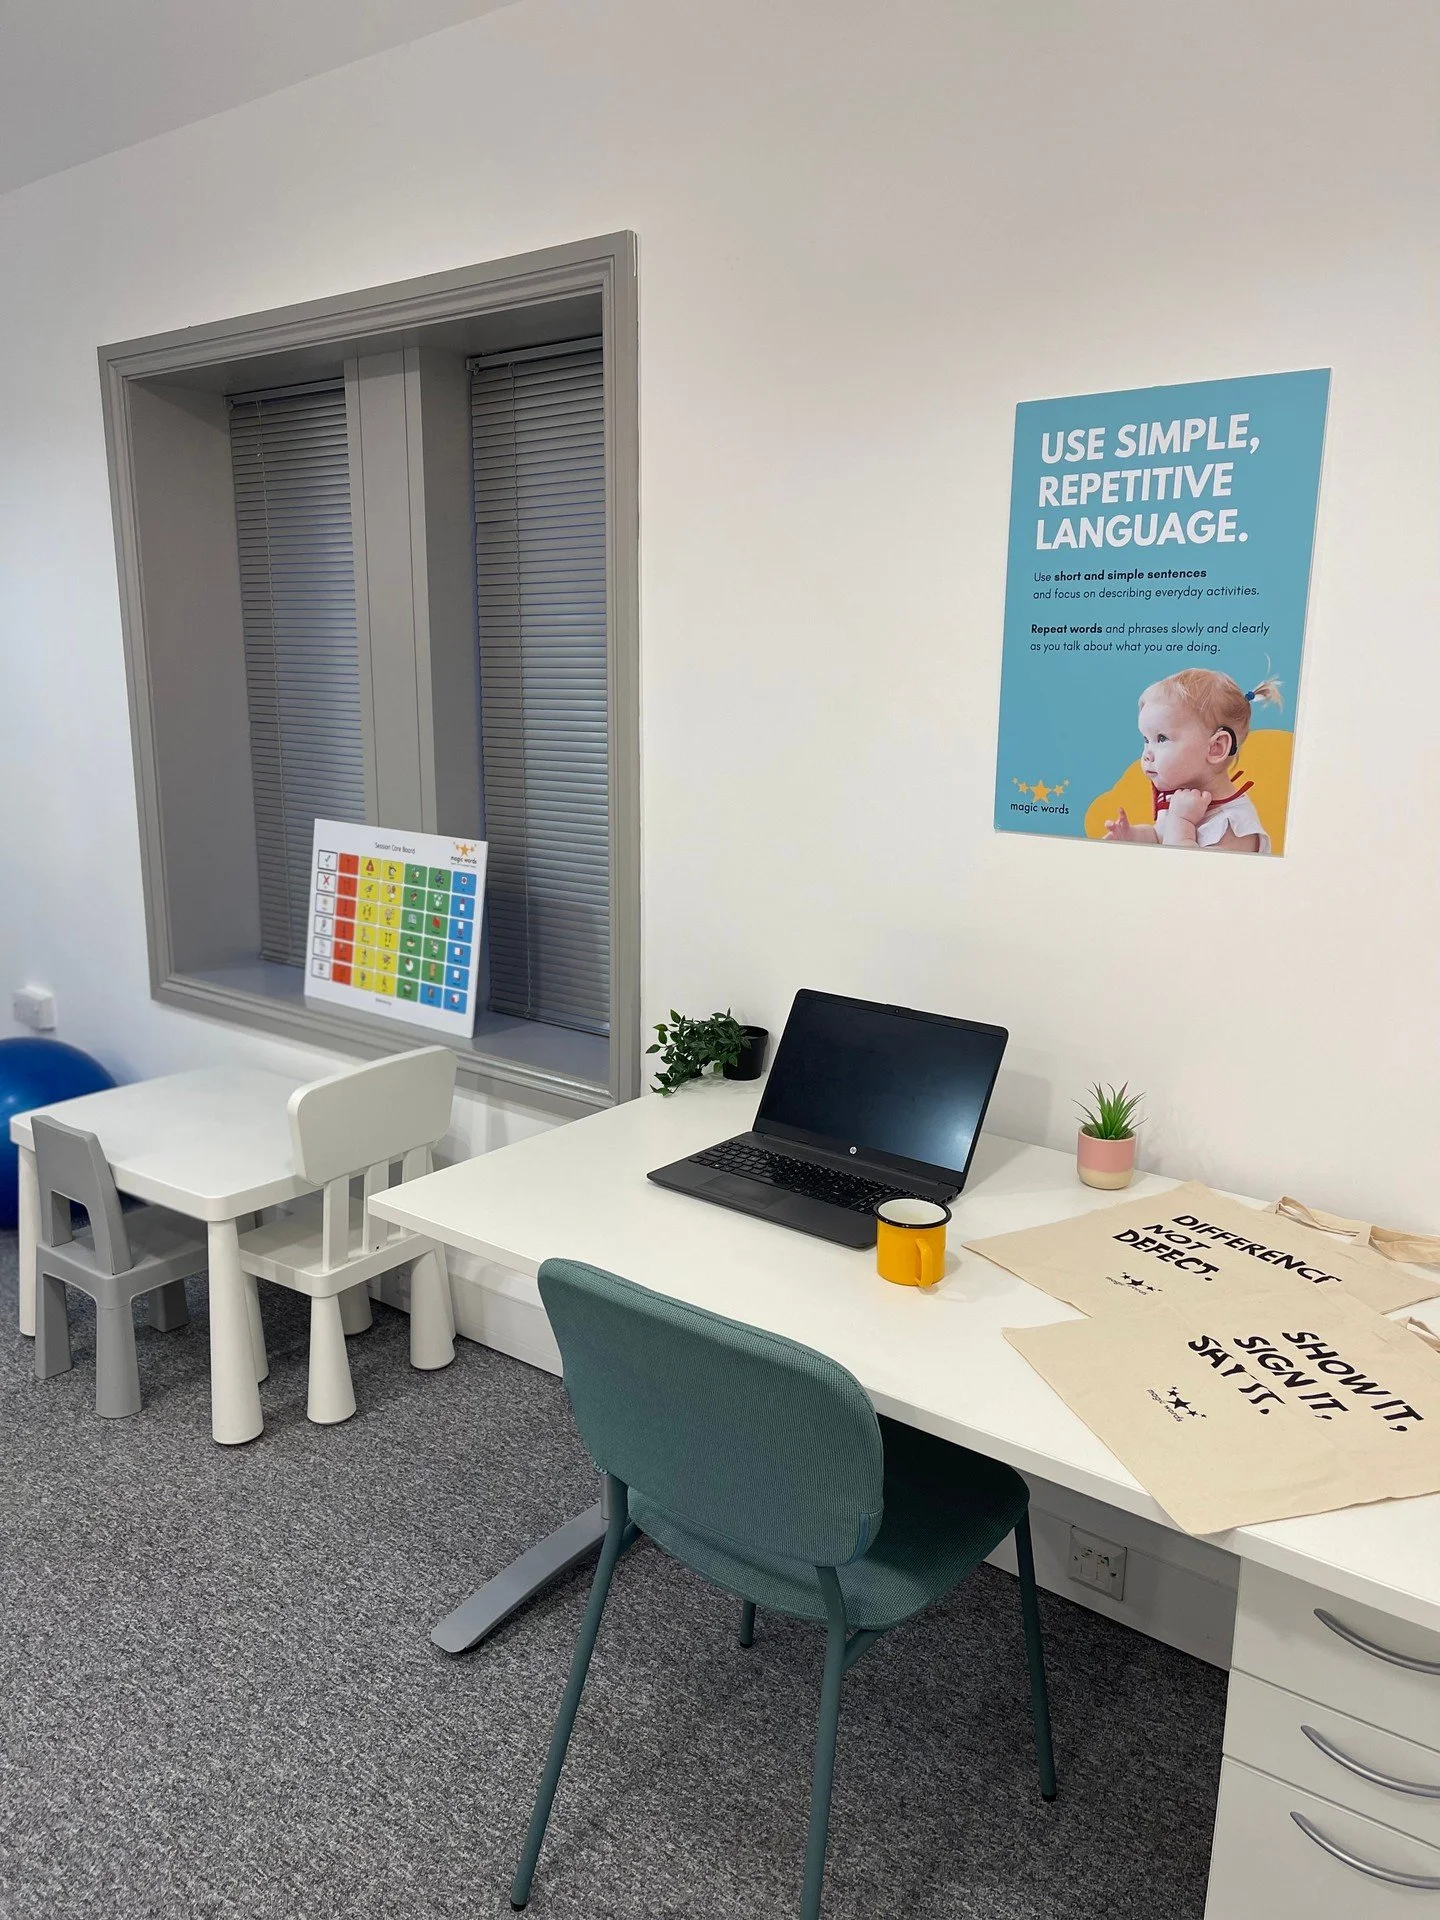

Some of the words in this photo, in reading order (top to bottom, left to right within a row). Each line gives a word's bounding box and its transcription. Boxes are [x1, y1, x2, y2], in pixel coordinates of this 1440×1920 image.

[1041, 427, 1106, 464] USE
[1114, 413, 1260, 457] SIMPLE,
[1038, 462, 1234, 508] REPETITIVE
[1036, 508, 1249, 550] LANGUAGE.
[1033, 588, 1051, 599] and
[1054, 588, 1080, 599] focus
[1083, 589, 1096, 598] on
[1099, 587, 1152, 600] describing
[1155, 587, 1204, 600] everyday
[1206, 586, 1259, 596] activities.
[1034, 572, 1051, 582] Use
[1054, 571, 1081, 581] short
[1084, 570, 1105, 580] and
[1108, 569, 1144, 582] simple
[1147, 569, 1207, 579] sentences
[1030, 642, 1041, 651] as
[1043, 642, 1060, 653] you
[1063, 641, 1080, 651] talk
[1083, 641, 1112, 651] about
[1115, 641, 1141, 651] what
[1144, 642, 1162, 654] you
[1166, 643, 1183, 651] are
[1187, 641, 1221, 654] doing.
[1031, 624, 1067, 635] Repeat
[1070, 624, 1103, 634] words
[1105, 623, 1125, 634] and
[1128, 623, 1168, 636] phrases
[1171, 623, 1204, 636] slowly
[1207, 622, 1228, 634] and
[1232, 622, 1270, 636] clearly
[1011, 803, 1038, 814] magic
[1041, 804, 1069, 814] words
[1113, 1229, 1220, 1286] DEFECT.
[1143, 1225, 1212, 1250] NOT
[1188, 1335, 1258, 1380] SAY
[1233, 1336, 1318, 1388] SIGN
[1298, 1391, 1349, 1420] IT,
[1282, 1332, 1391, 1396] SHOW
[1371, 1399, 1424, 1432] IT,
